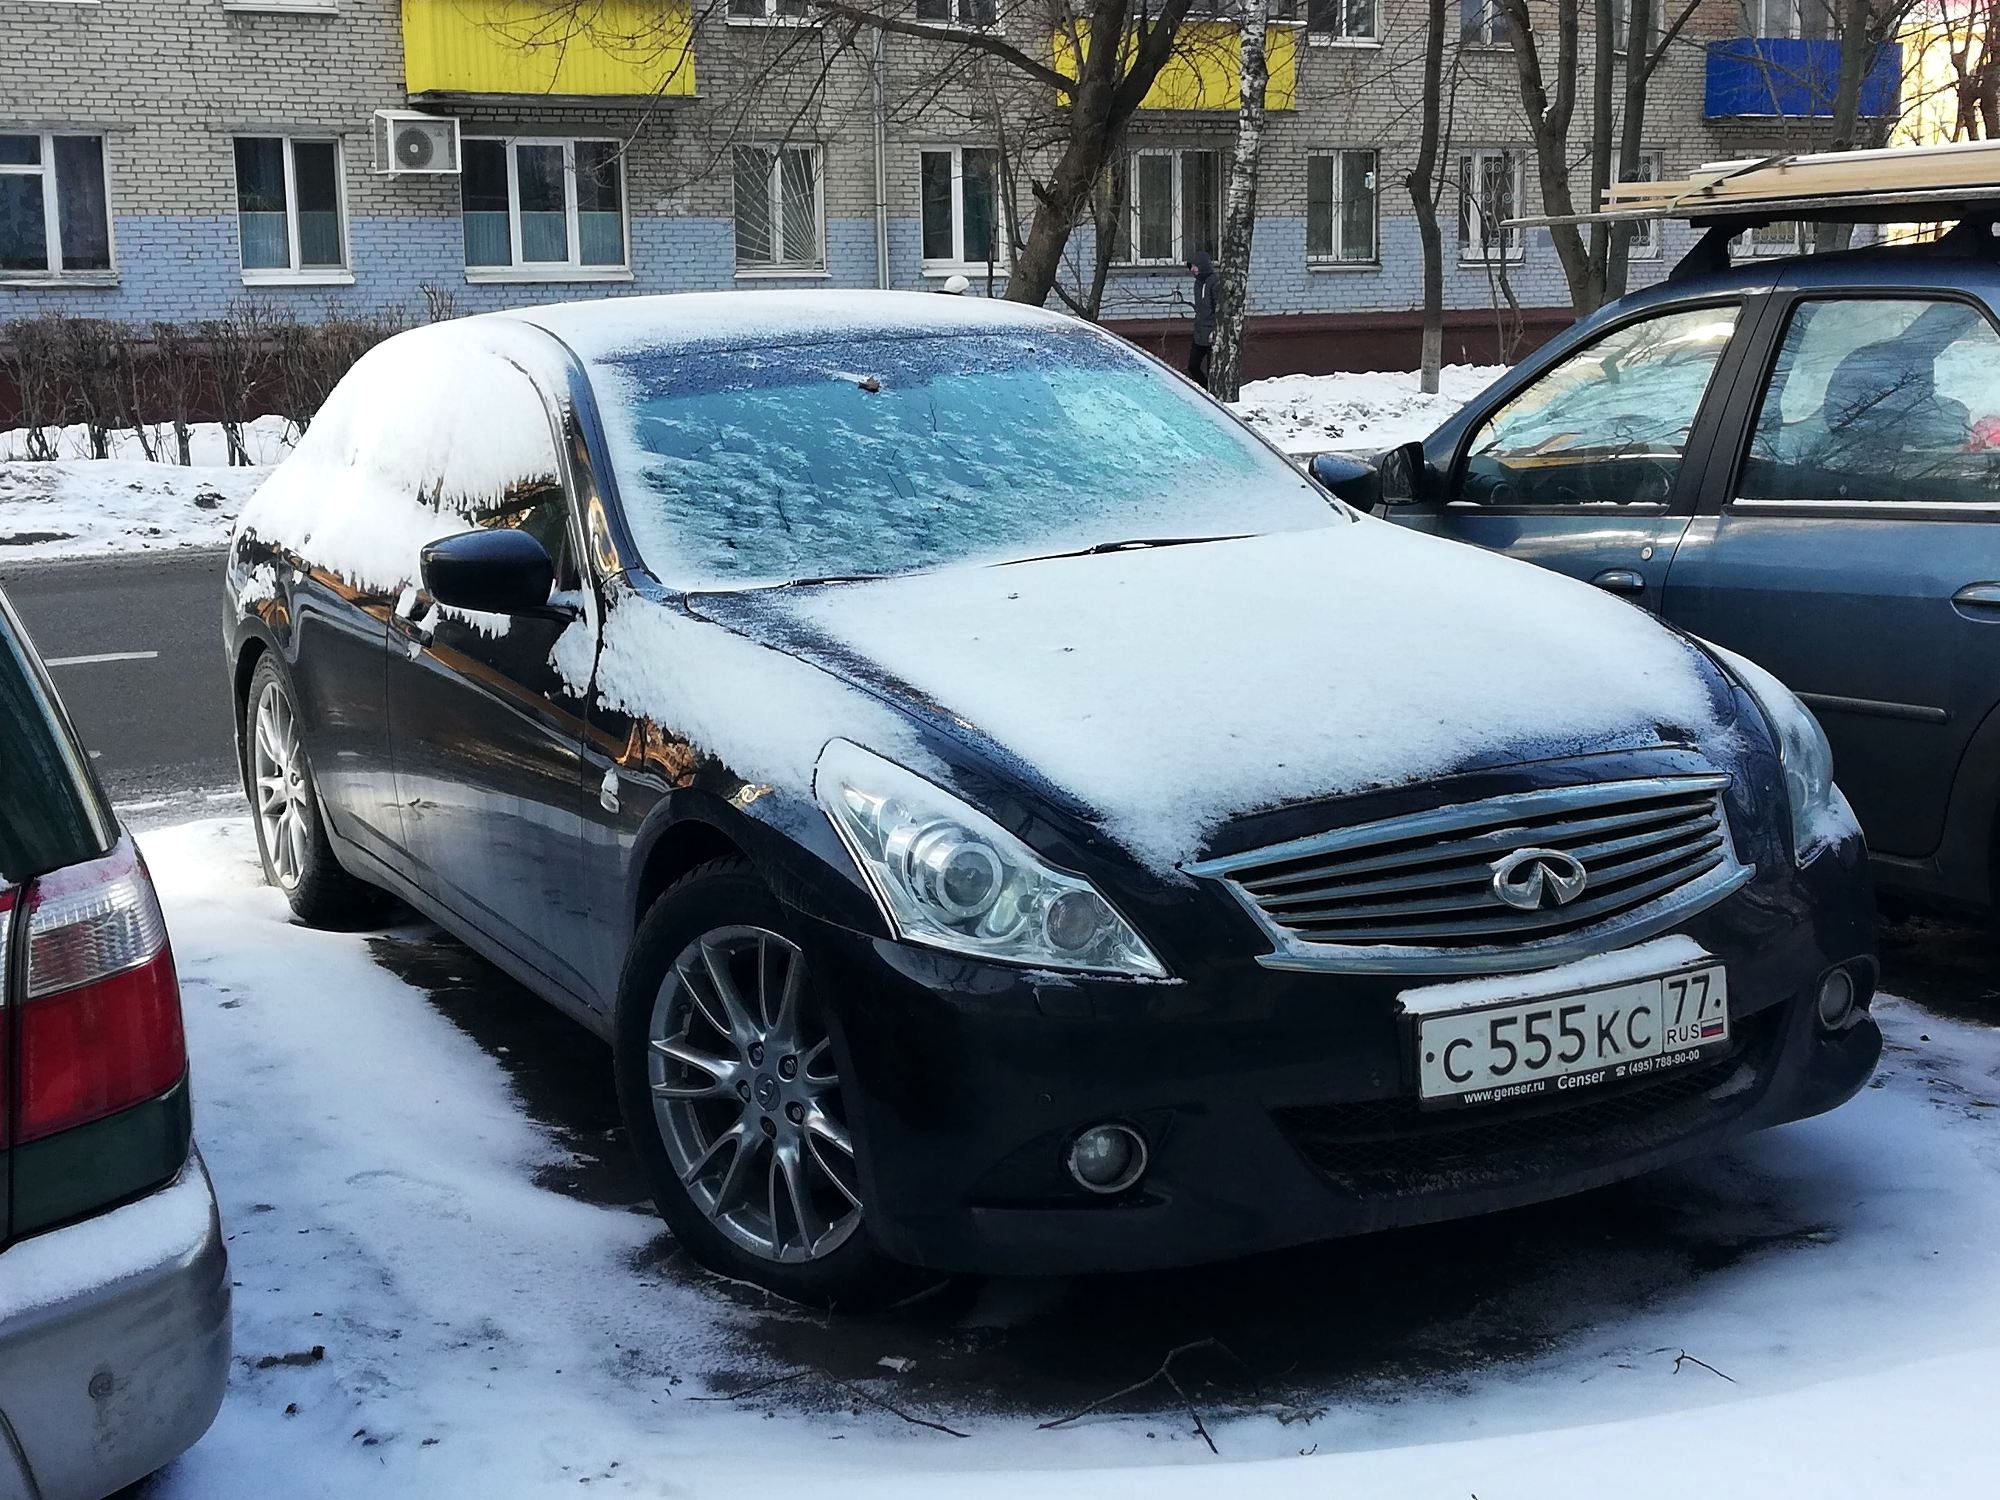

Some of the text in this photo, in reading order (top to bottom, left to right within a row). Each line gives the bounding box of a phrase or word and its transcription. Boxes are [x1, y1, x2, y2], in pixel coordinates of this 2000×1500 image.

[1668, 974, 1710, 1024] 77
[1667, 1024, 1700, 1045] RUS
[1464, 1050, 1700, 1104] www.genser.ru Genser (495) 788-90-00
